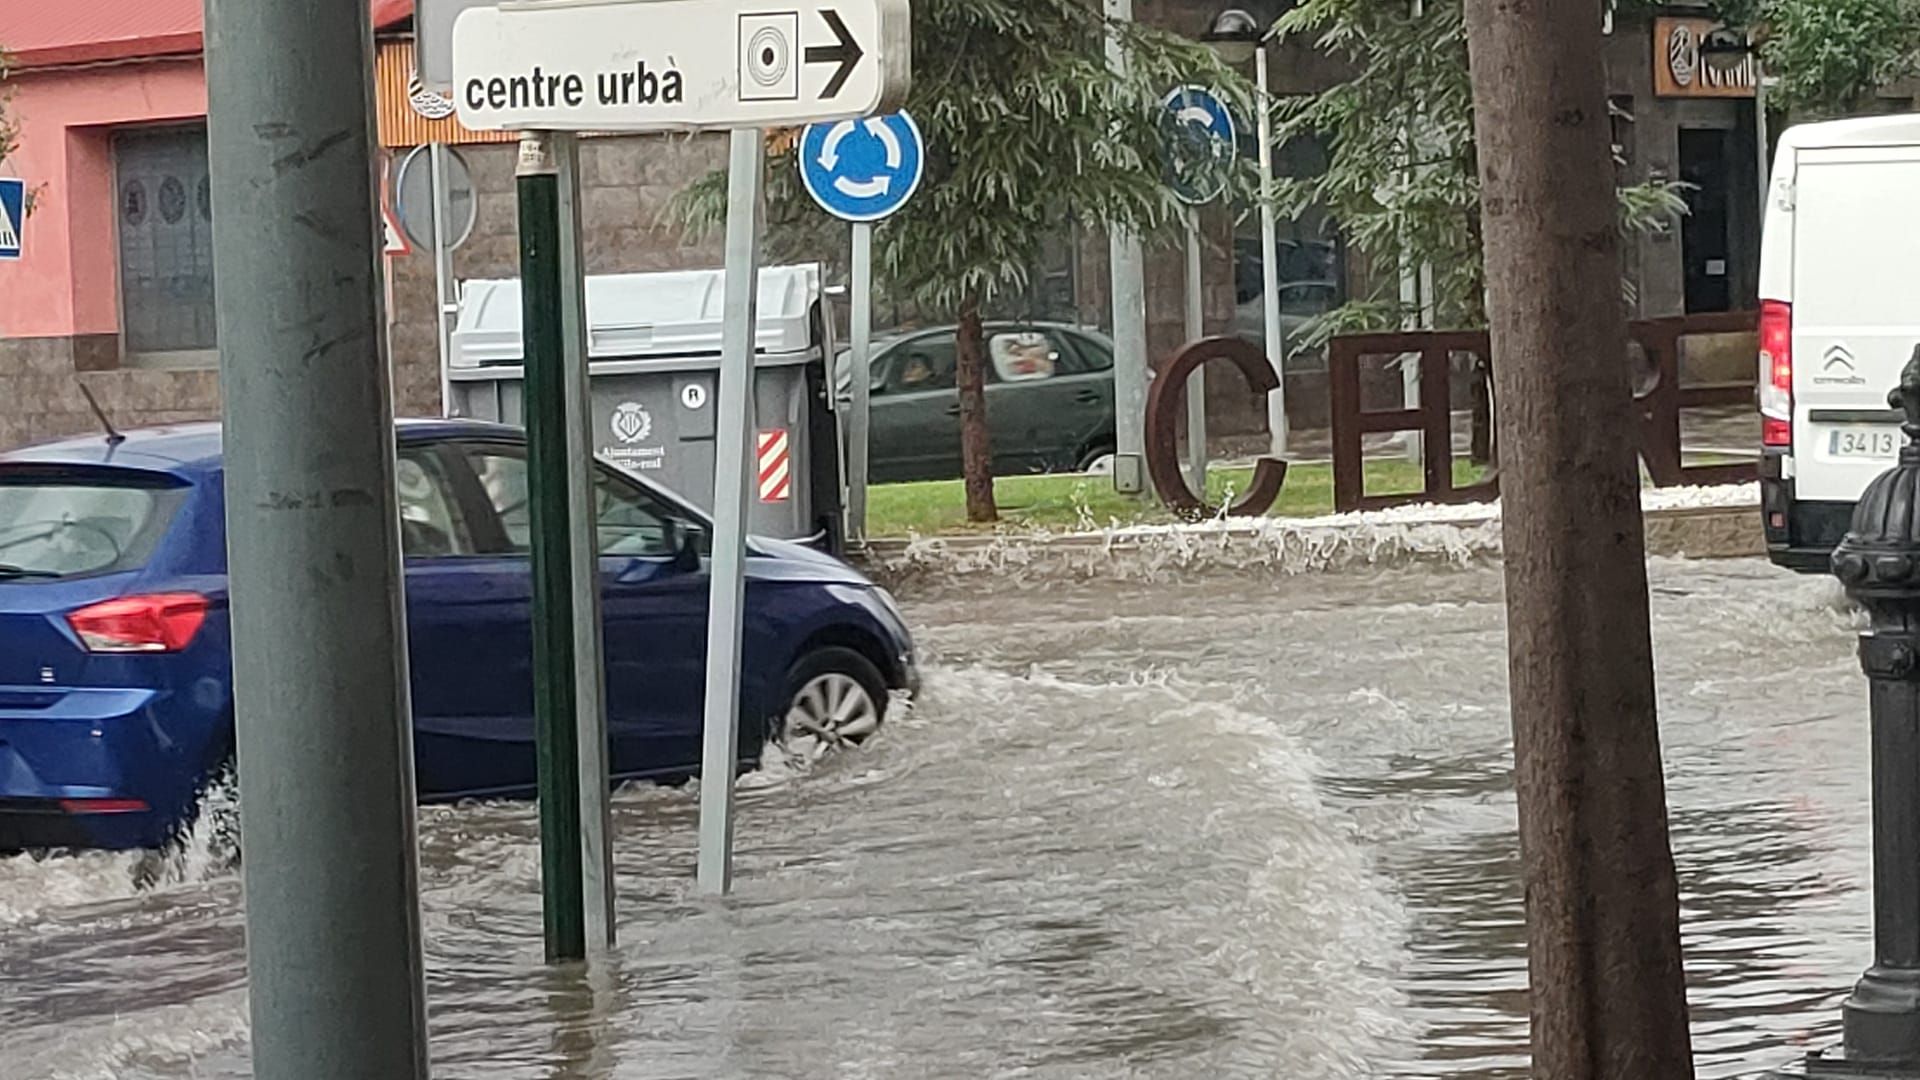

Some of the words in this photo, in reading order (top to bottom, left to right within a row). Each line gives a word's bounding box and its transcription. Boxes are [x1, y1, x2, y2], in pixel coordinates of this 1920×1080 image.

[466, 66, 584, 111] centre
[597, 55, 684, 105] urbà
[1842, 433, 1893, 453] 3413
